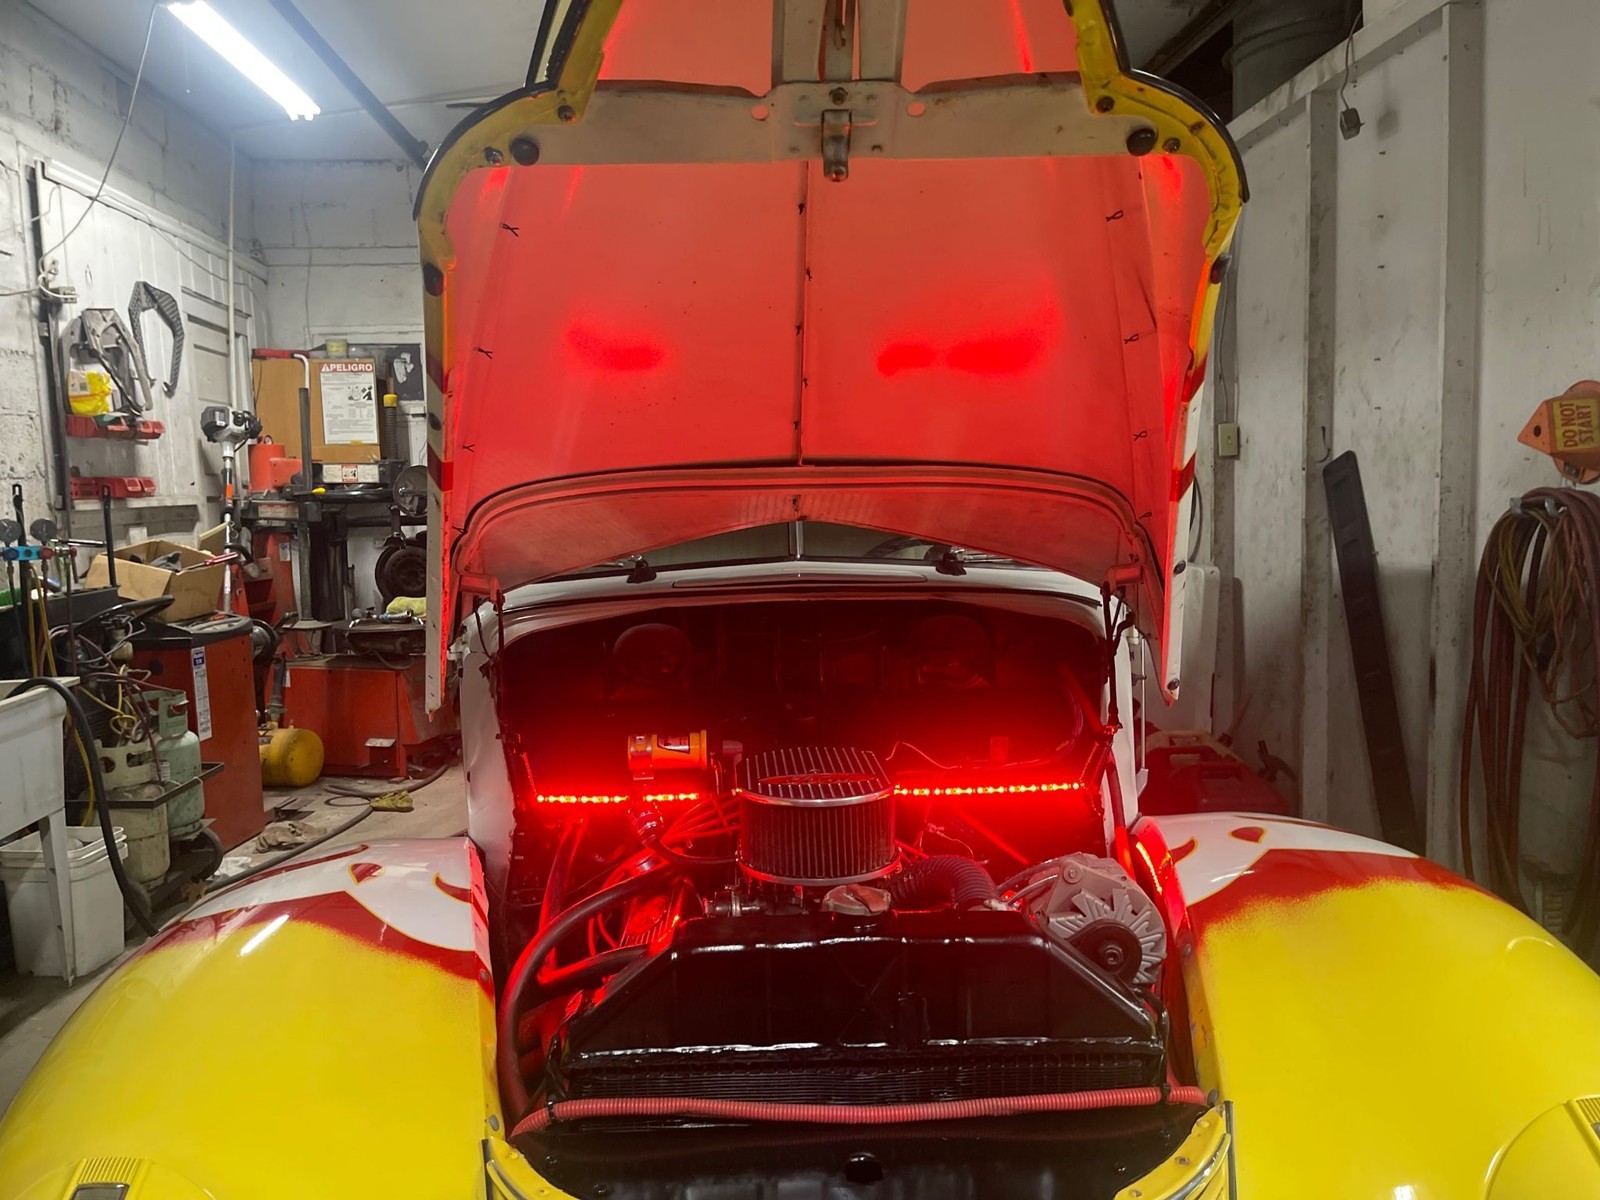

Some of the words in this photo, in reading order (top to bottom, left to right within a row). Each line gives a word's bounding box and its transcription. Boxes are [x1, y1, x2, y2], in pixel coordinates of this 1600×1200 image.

[330, 363, 373, 372] PELIGRO
[1559, 403, 1576, 427] NOT
[1576, 405, 1594, 443] START
[1562, 430, 1578, 447] DO
